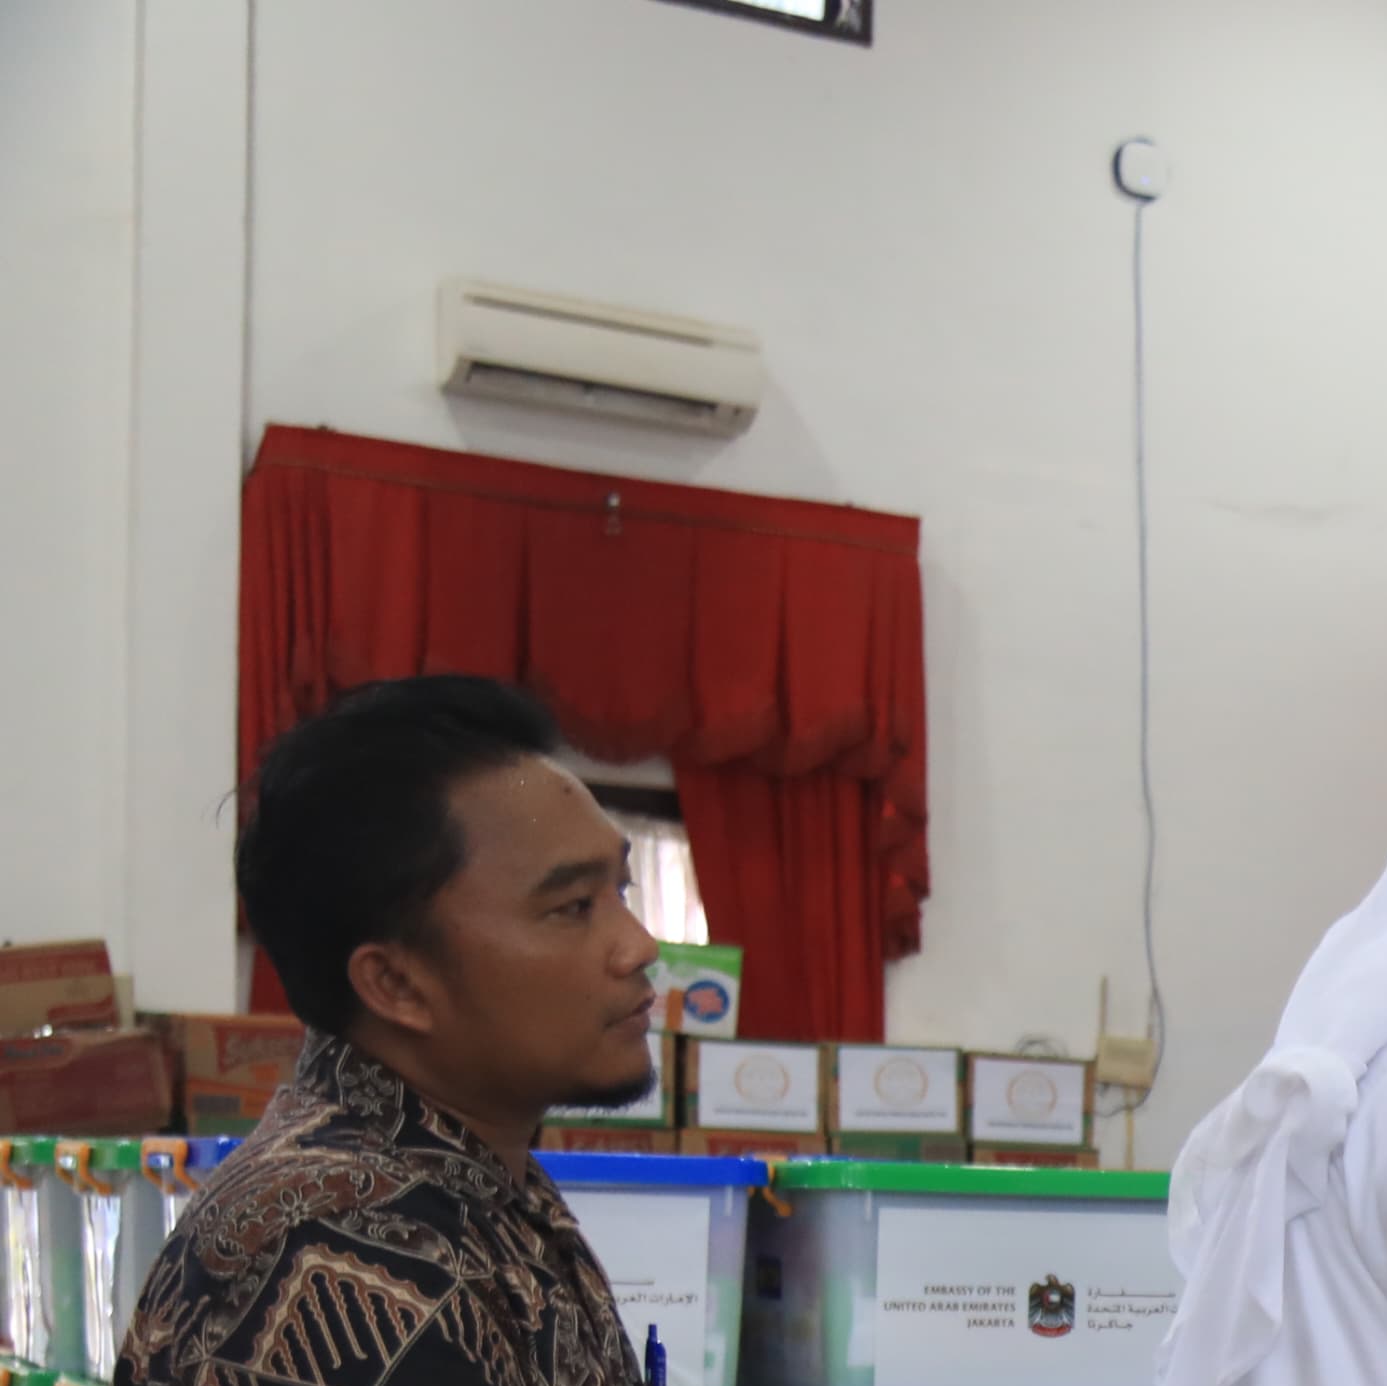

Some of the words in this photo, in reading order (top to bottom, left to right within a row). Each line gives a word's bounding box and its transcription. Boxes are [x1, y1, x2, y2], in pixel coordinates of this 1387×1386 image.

[923, 1285, 975, 1296] EMBASSY
[976, 1285, 992, 1297] OF
[995, 1286, 1016, 1297] THE
[883, 1301, 926, 1312] UNITED
[929, 1301, 960, 1312] ARAB
[962, 1301, 1016, 1312] EMIRATES
[967, 1317, 1015, 1329] JAKARTA
